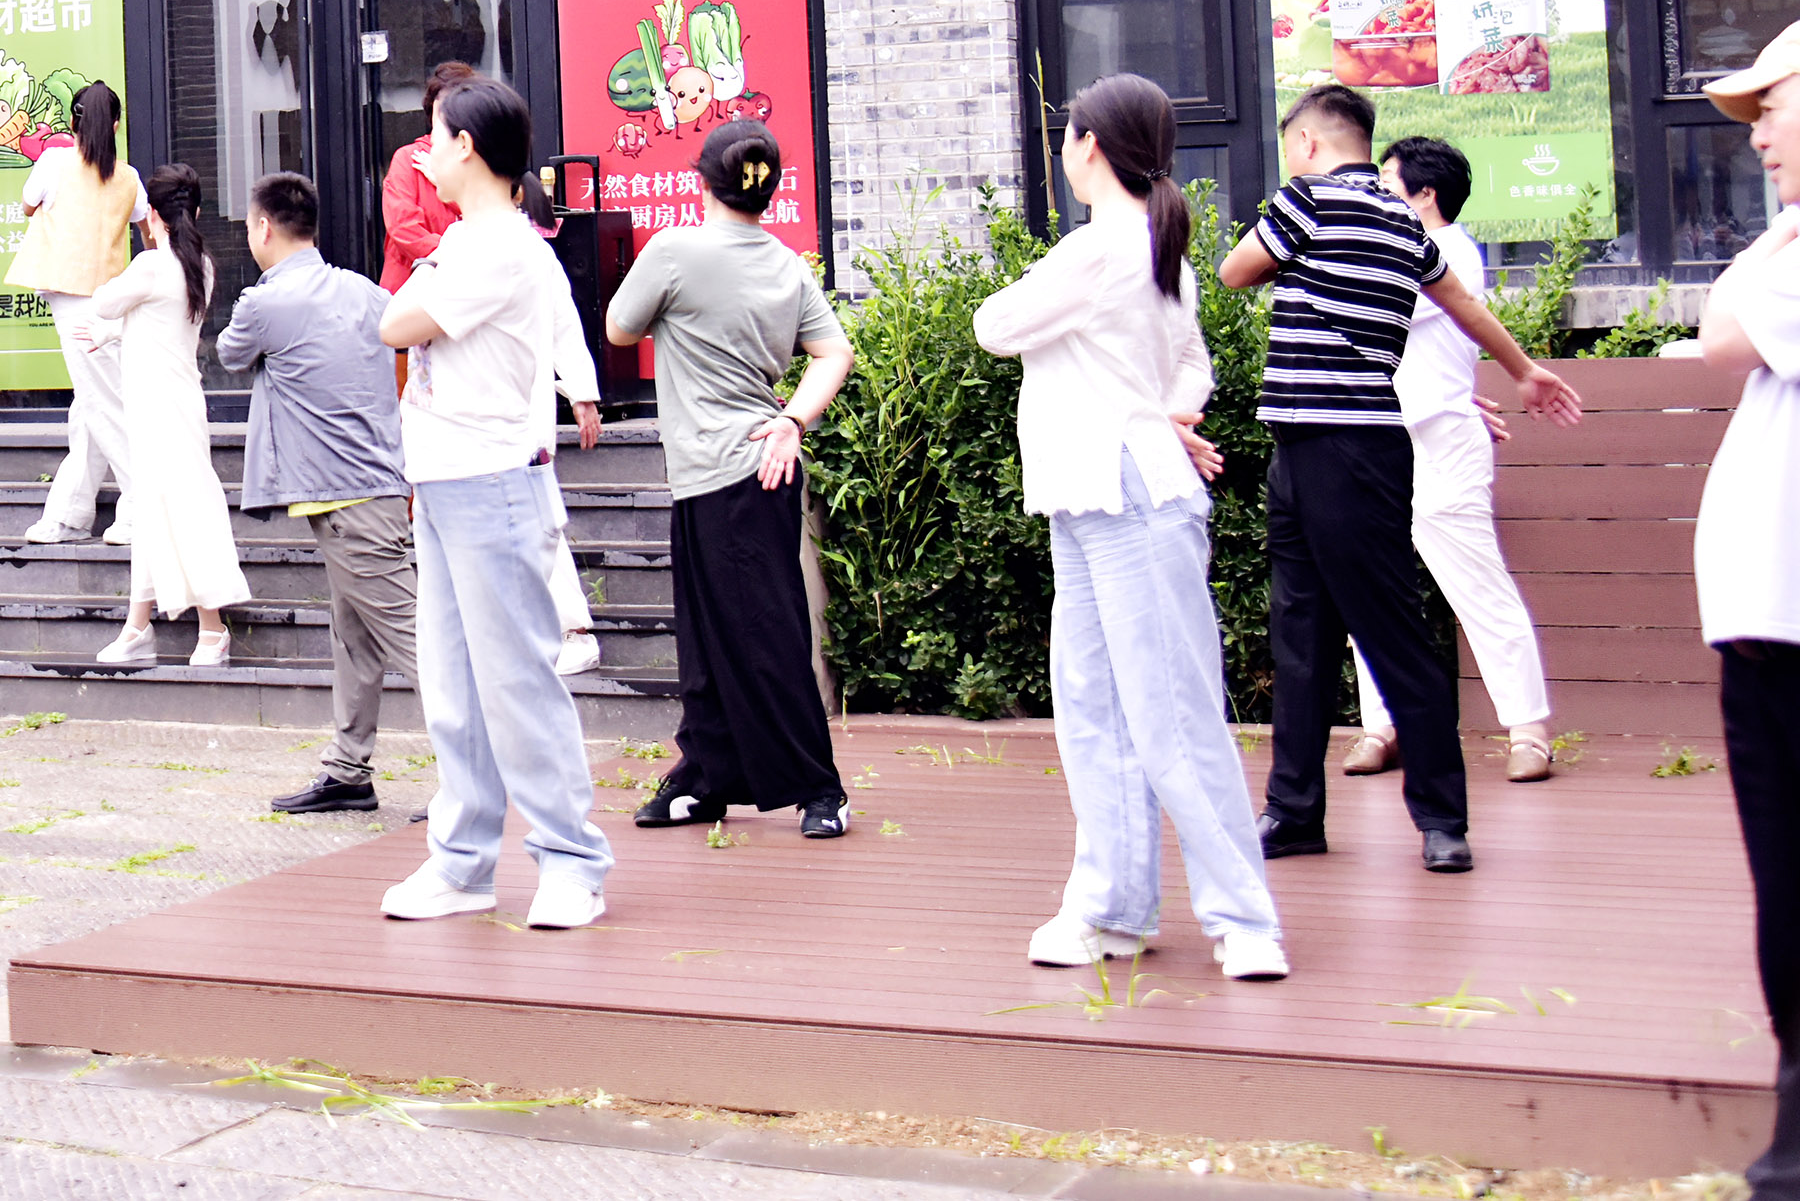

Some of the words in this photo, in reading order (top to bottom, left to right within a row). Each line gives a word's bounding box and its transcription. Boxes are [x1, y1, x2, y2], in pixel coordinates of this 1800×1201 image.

[580, 165, 799, 200] 天然食材筑石
[1509, 183, 1577, 198] 色香味俱全
